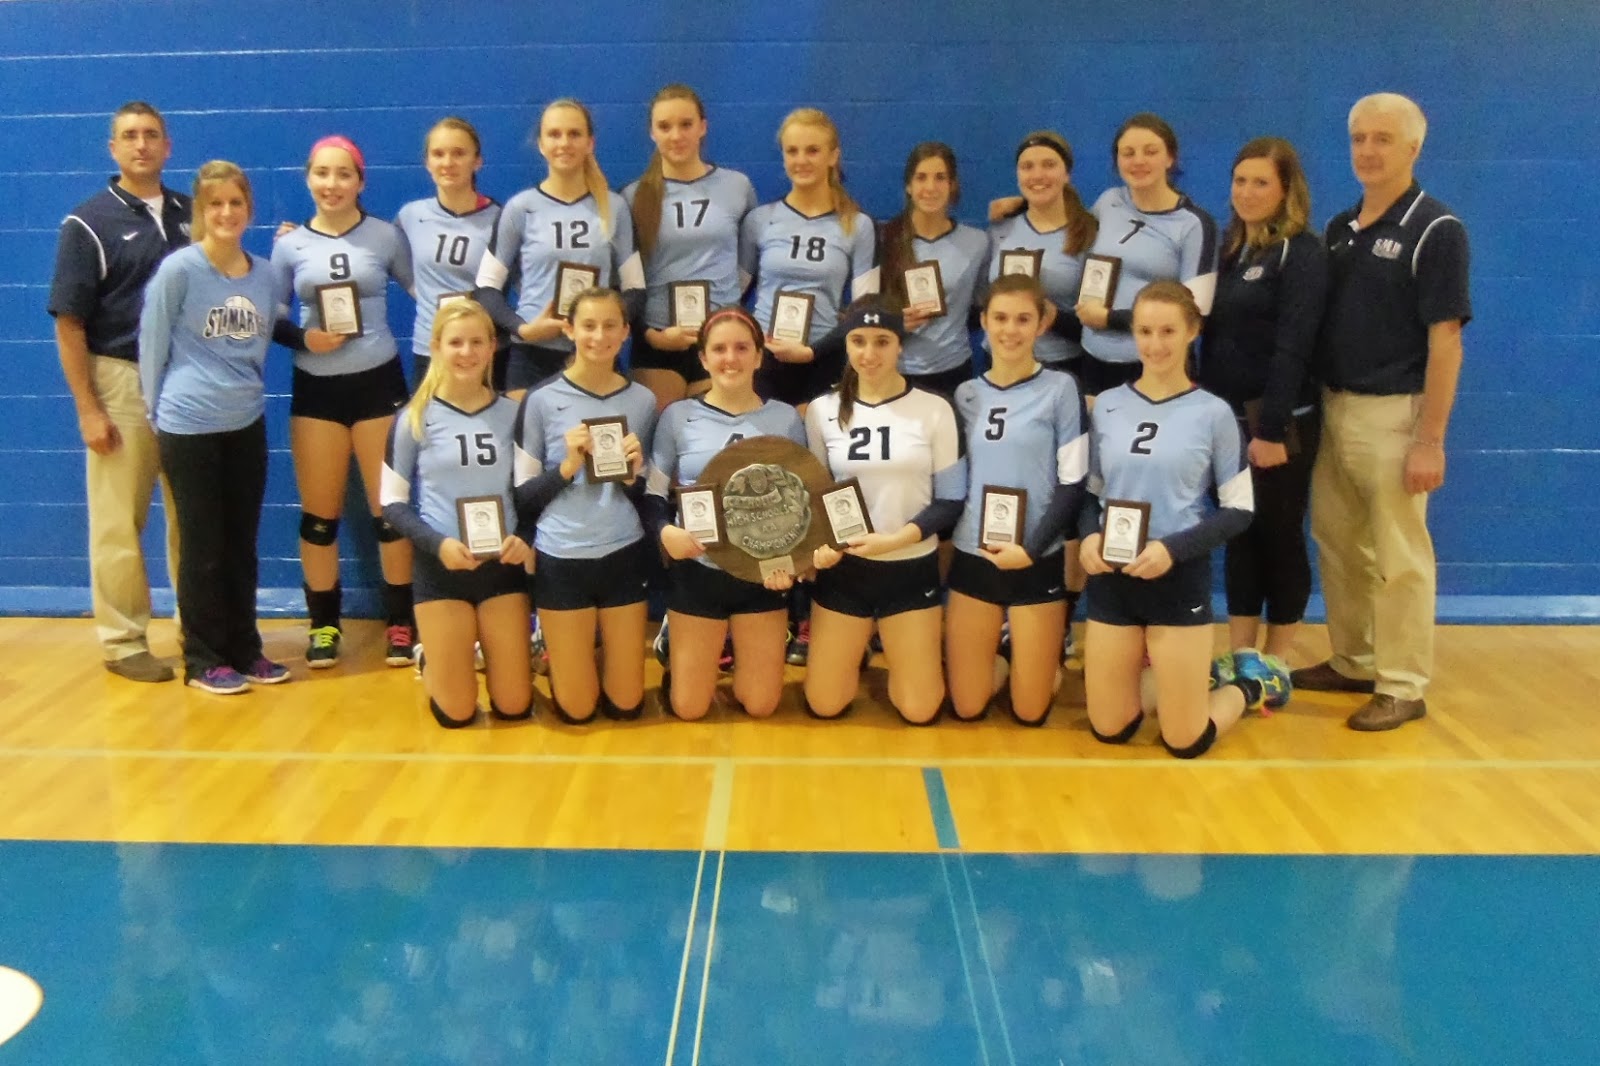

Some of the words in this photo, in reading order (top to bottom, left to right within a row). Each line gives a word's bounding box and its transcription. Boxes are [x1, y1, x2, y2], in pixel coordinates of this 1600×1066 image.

[672, 199, 710, 228] 17
[551, 219, 590, 249] 12
[1119, 219, 1146, 244] 7
[434, 233, 470, 266] 10
[790, 234, 826, 263] 18
[329, 252, 351, 281] 9
[984, 406, 1008, 442] 5
[1130, 422, 1160, 455] 2
[455, 433, 498, 466] 15
[848, 425, 891, 461] 21
[742, 523, 801, 550] CHAMPIONSHIP
